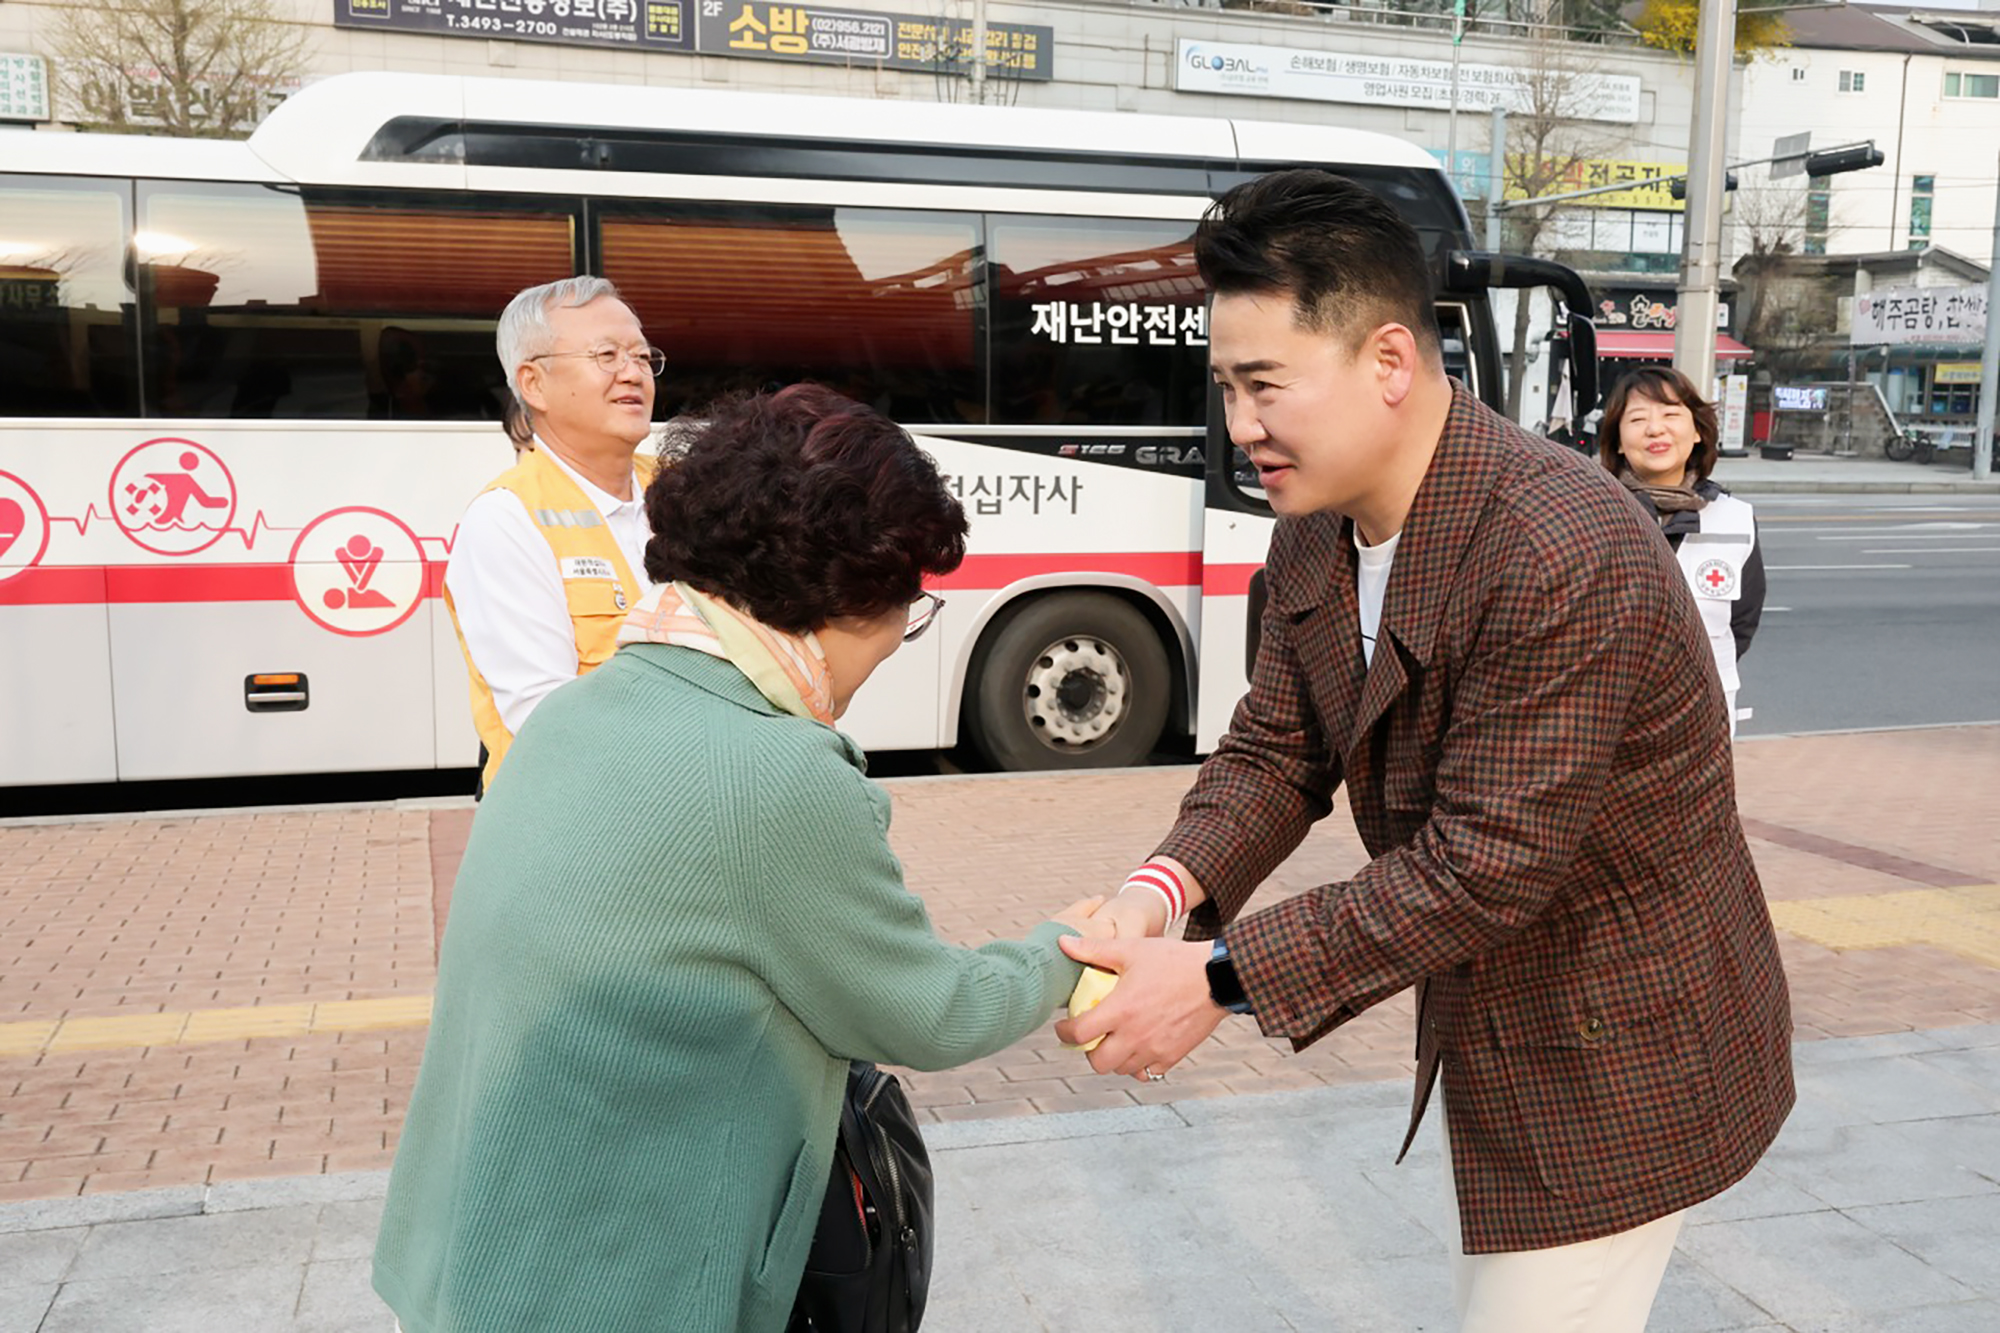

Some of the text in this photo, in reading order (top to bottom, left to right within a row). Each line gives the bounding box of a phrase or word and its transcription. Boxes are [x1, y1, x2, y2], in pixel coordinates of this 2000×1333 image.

[703, 1, 723, 17] 2F
[729, 5, 809, 54] 소방
[1290, 55, 1337, 72] 손해보험
[1345, 60, 1390, 76] 생명보험
[1363, 82, 1409, 99] 영업사원
[1411, 86, 1432, 100] 모집
[1030, 301, 1209, 346] 재난안전센
